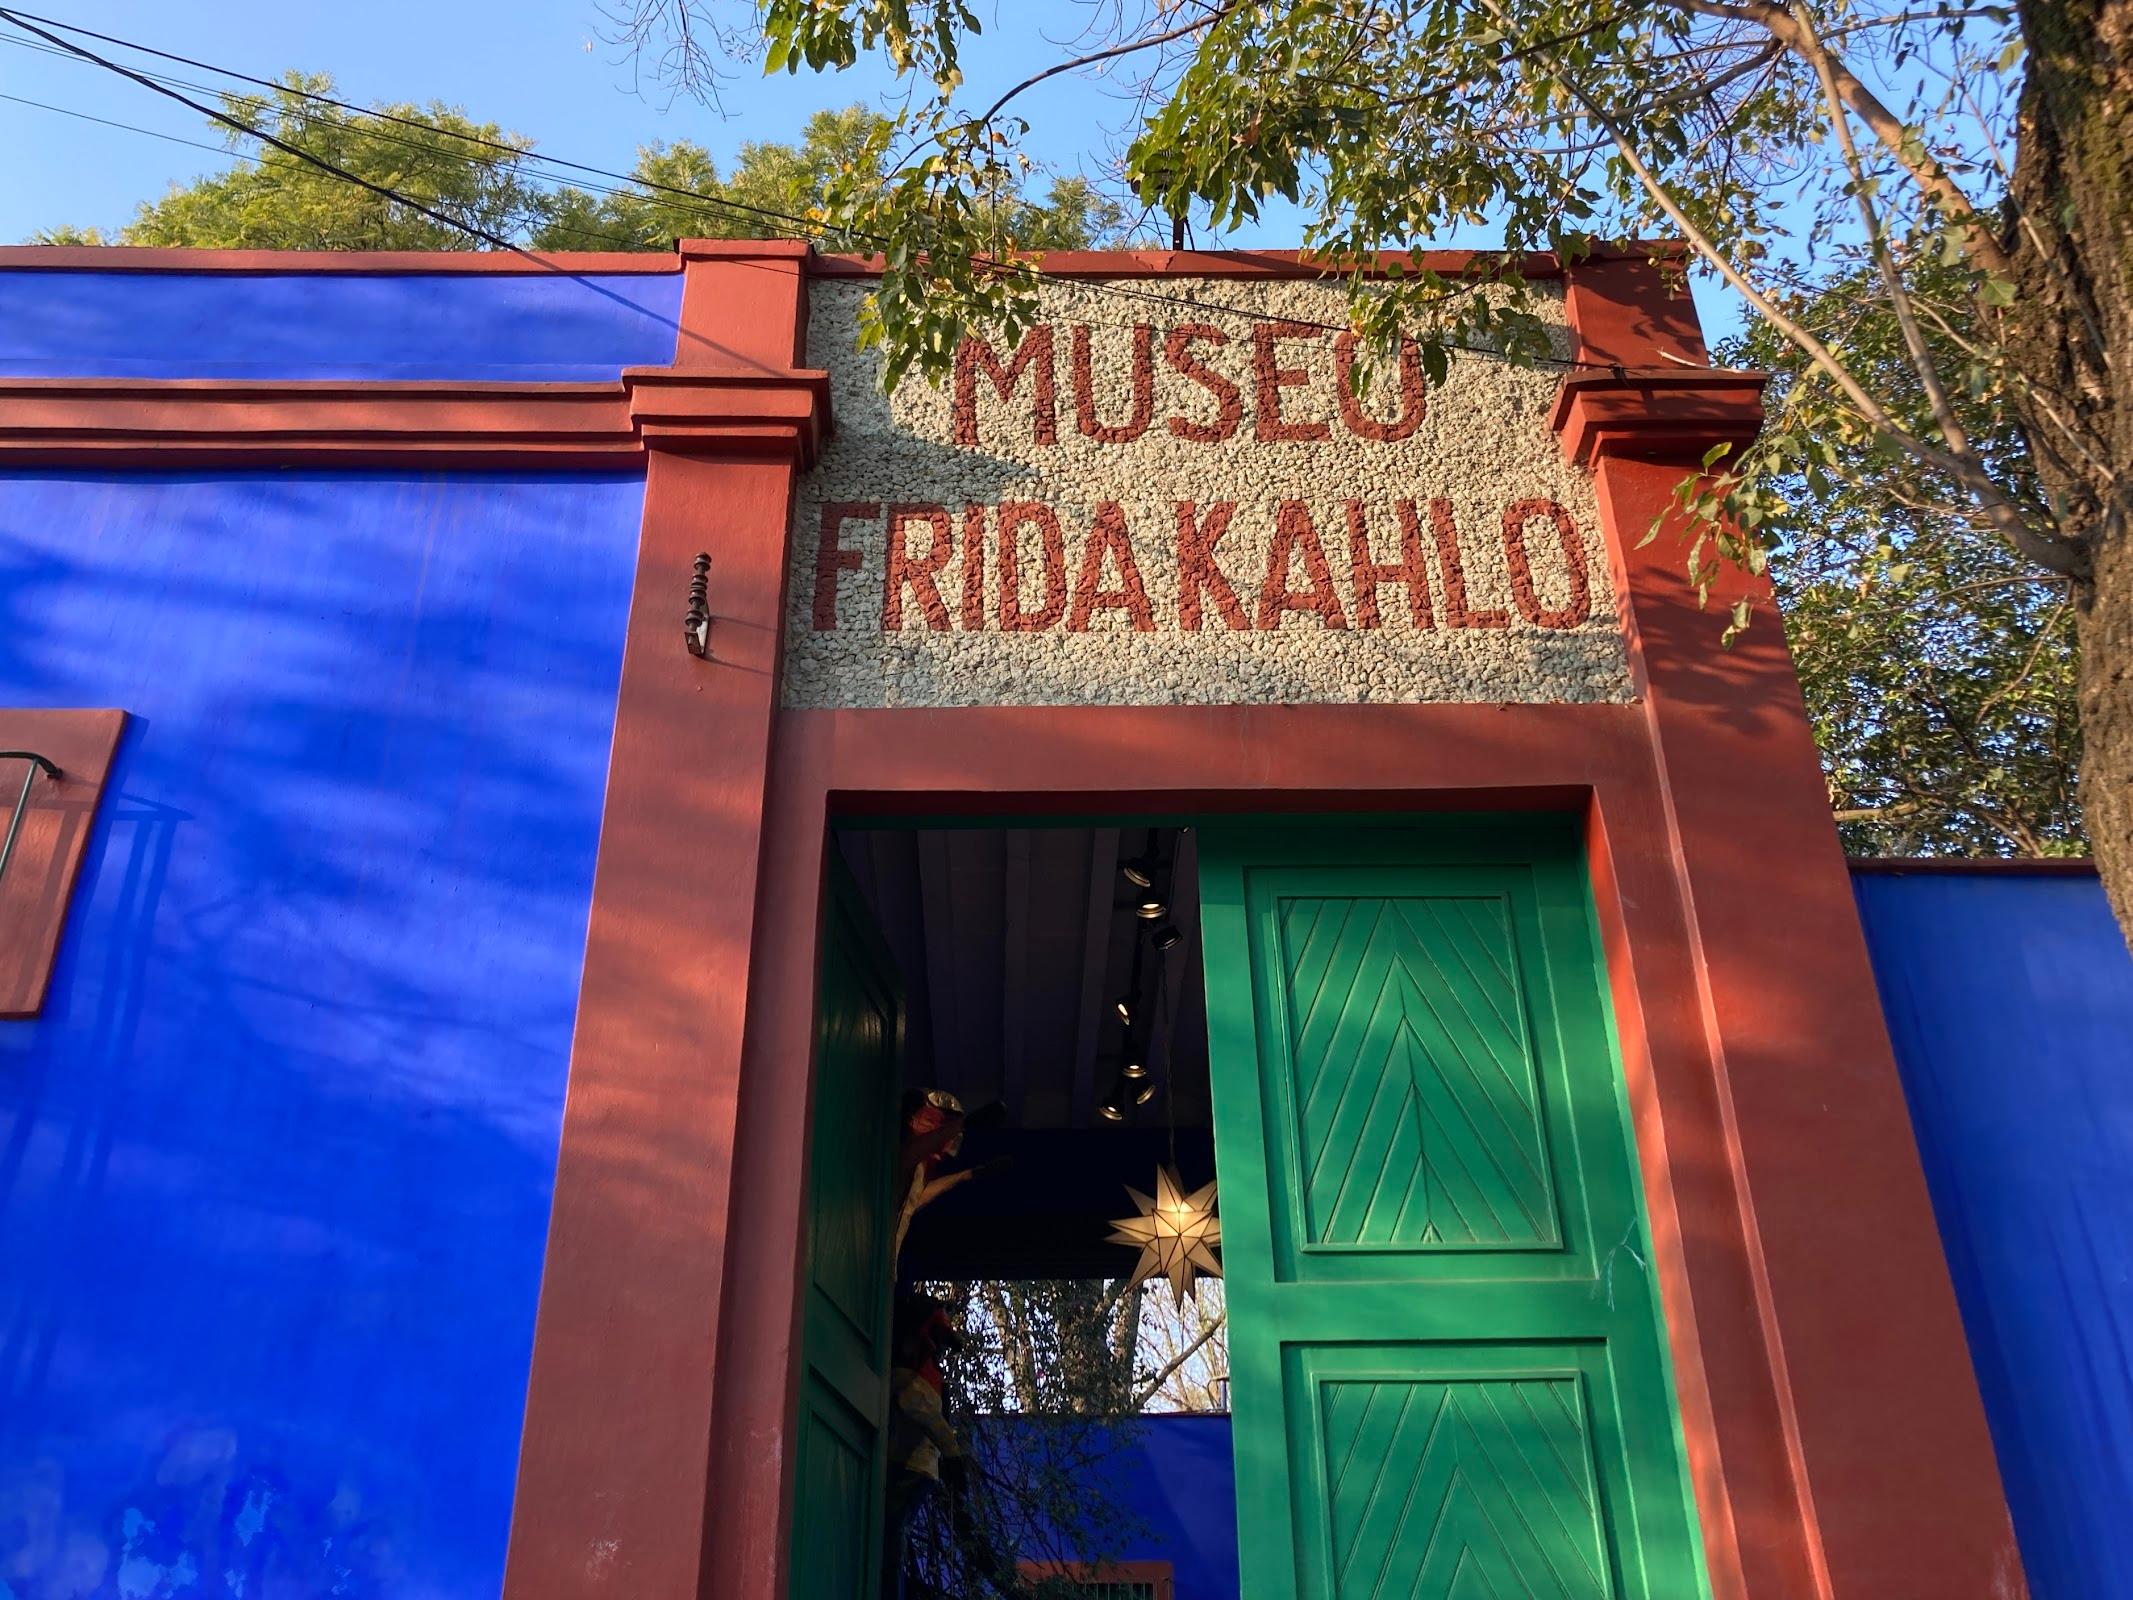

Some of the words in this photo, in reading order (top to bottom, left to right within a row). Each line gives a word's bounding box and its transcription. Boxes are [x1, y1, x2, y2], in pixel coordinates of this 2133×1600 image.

[953, 322, 1428, 447] MUSEO
[812, 499, 1157, 634] FRIDA
[1176, 498, 1591, 632] KAHLO
